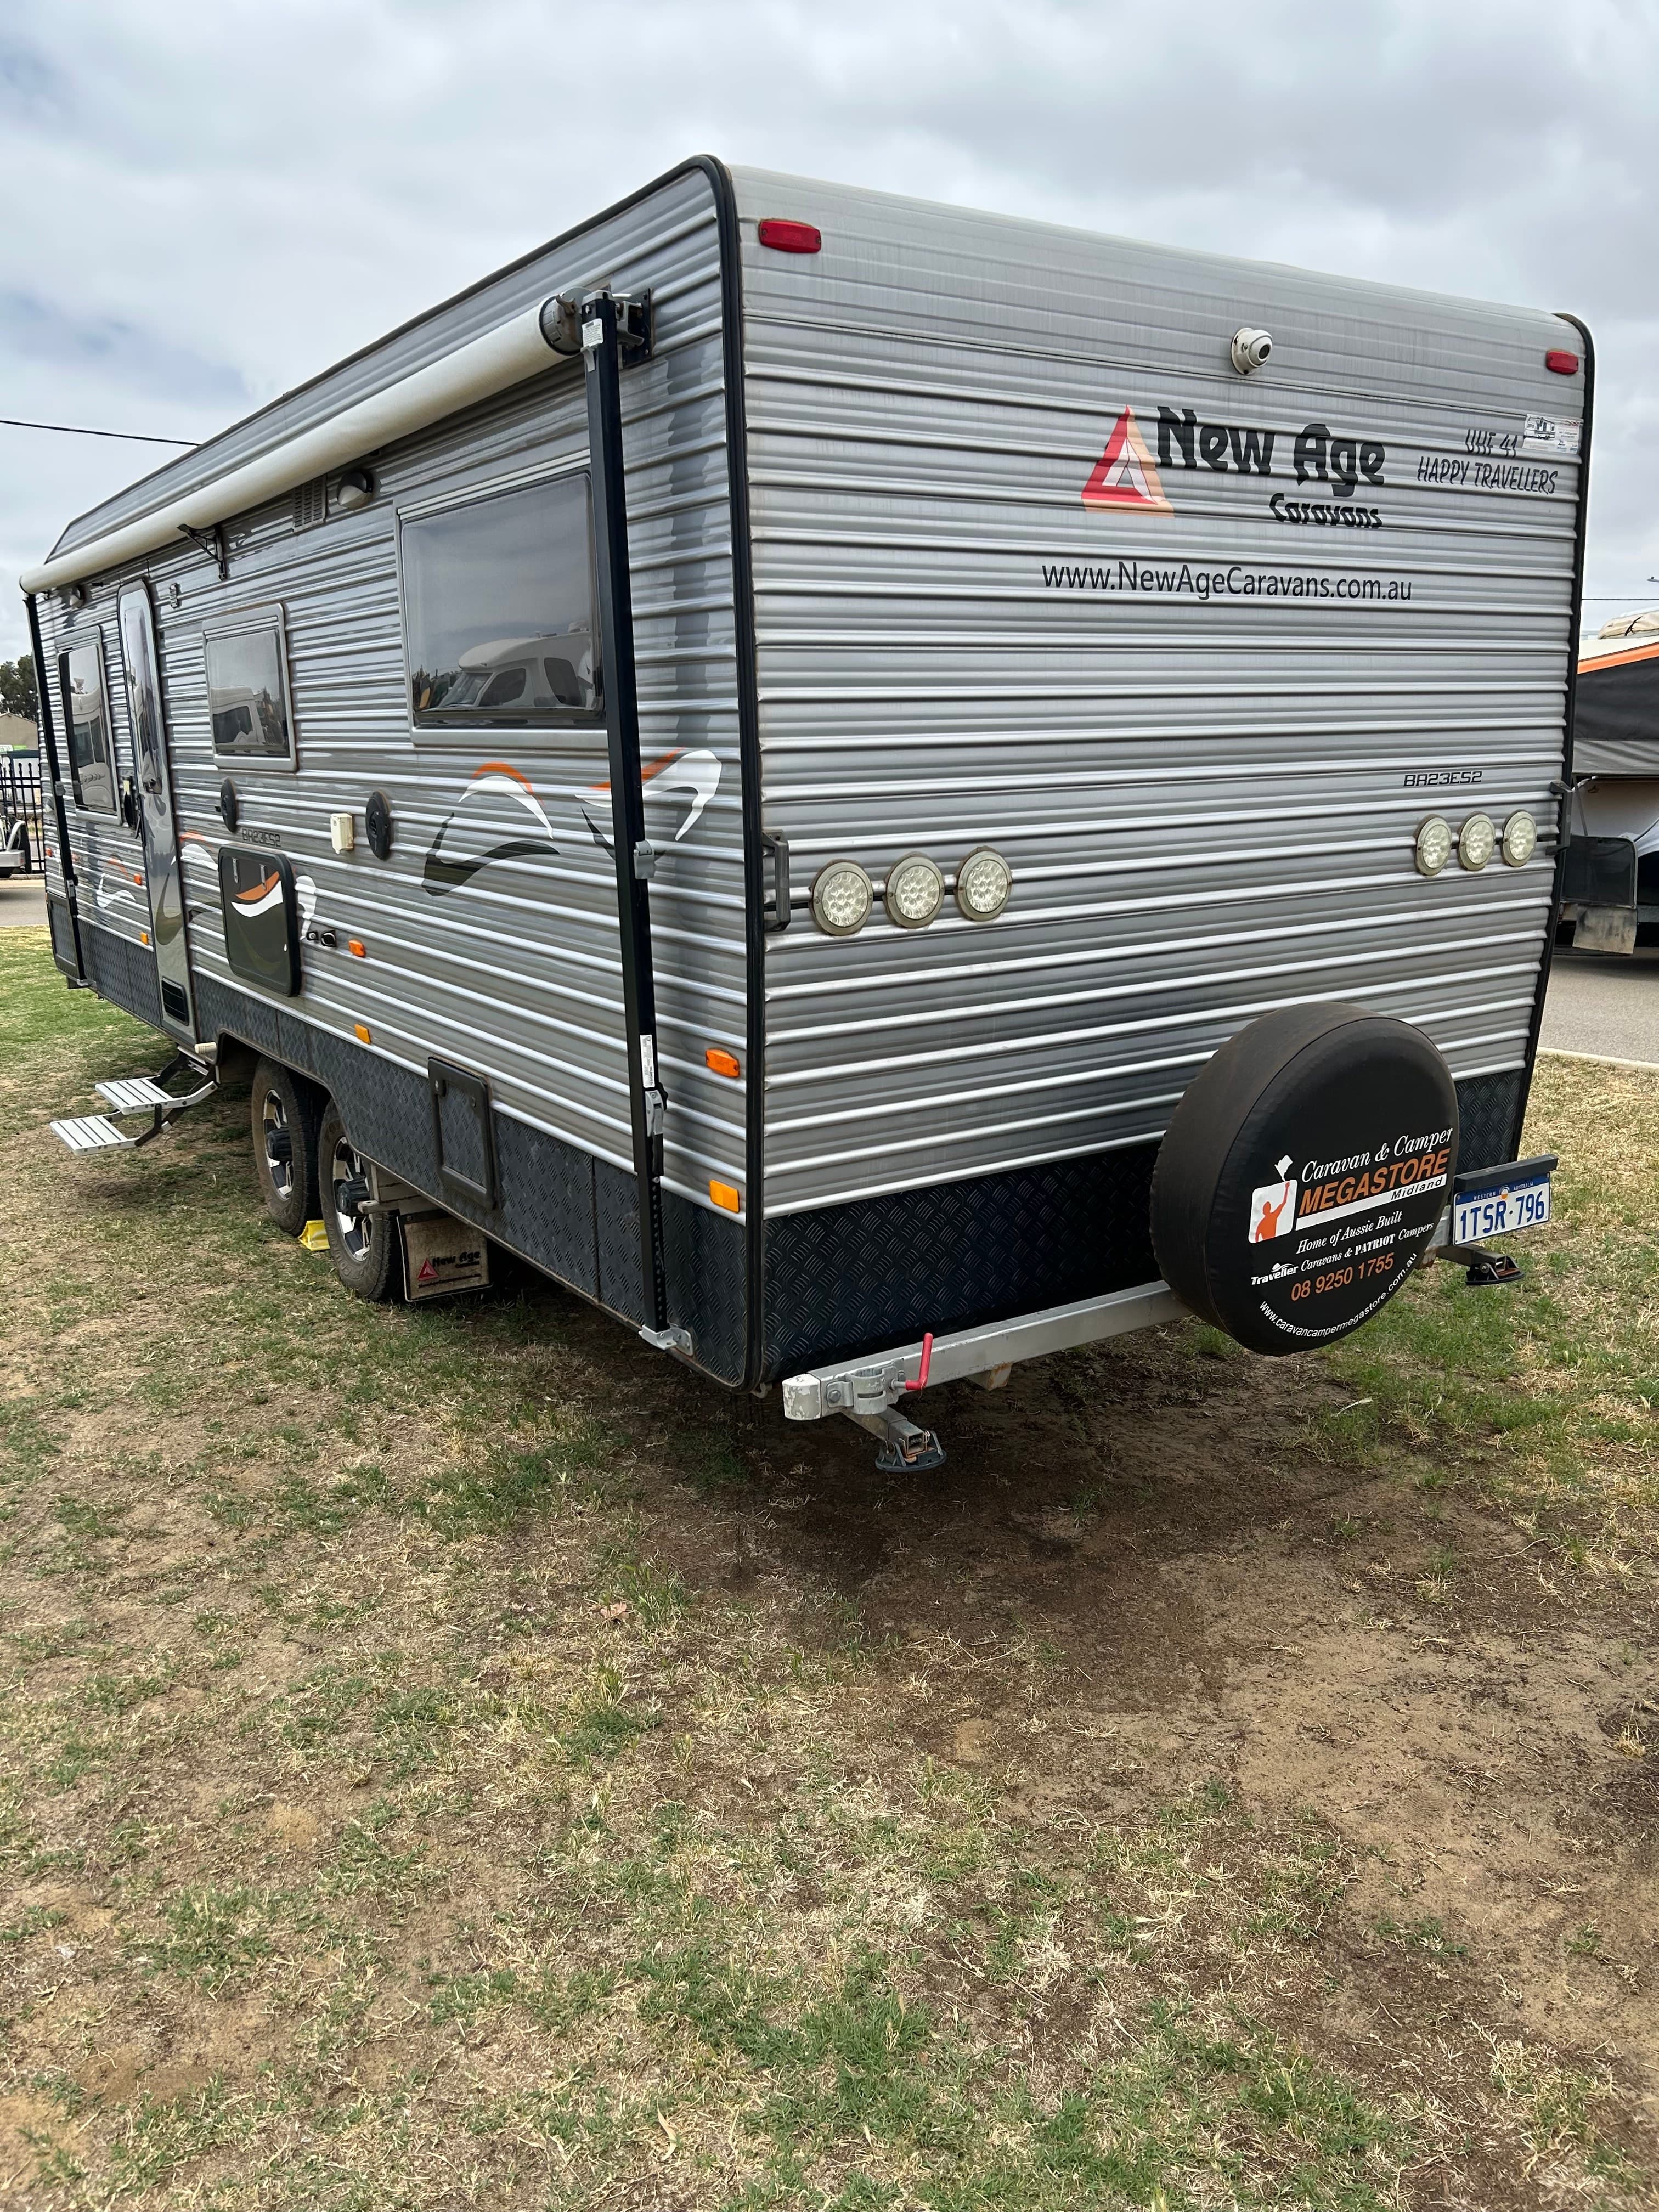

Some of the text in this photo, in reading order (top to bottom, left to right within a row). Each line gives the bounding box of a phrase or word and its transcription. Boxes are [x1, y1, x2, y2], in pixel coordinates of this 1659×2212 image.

[1157, 406, 1385, 497] New Age
[1465, 429, 1518, 458] UHF 41
[1417, 456, 1558, 494] HAPPY TRAVELLERS
[1269, 493, 1383, 528] Caravans
[1042, 561, 1412, 600] www.NewAgeCaravans.com.au
[1301, 1127, 1453, 1182] Caravan & Camper
[1299, 1148, 1451, 1216] MEGASTORE
[1391, 1177, 1444, 1200] Midland
[1474, 1181, 1534, 1200] WESTERN AUSTRALIA
[1251, 1222, 1434, 1285] Traveller Caravans & PATRIOT Campers
[1296, 1211, 1402, 1254] Home of Aussie Built
[1260, 1252, 1418, 1337] www.caravancampermegastore.com.au
[1291, 1252, 1395, 1301] 08 9250 1755
